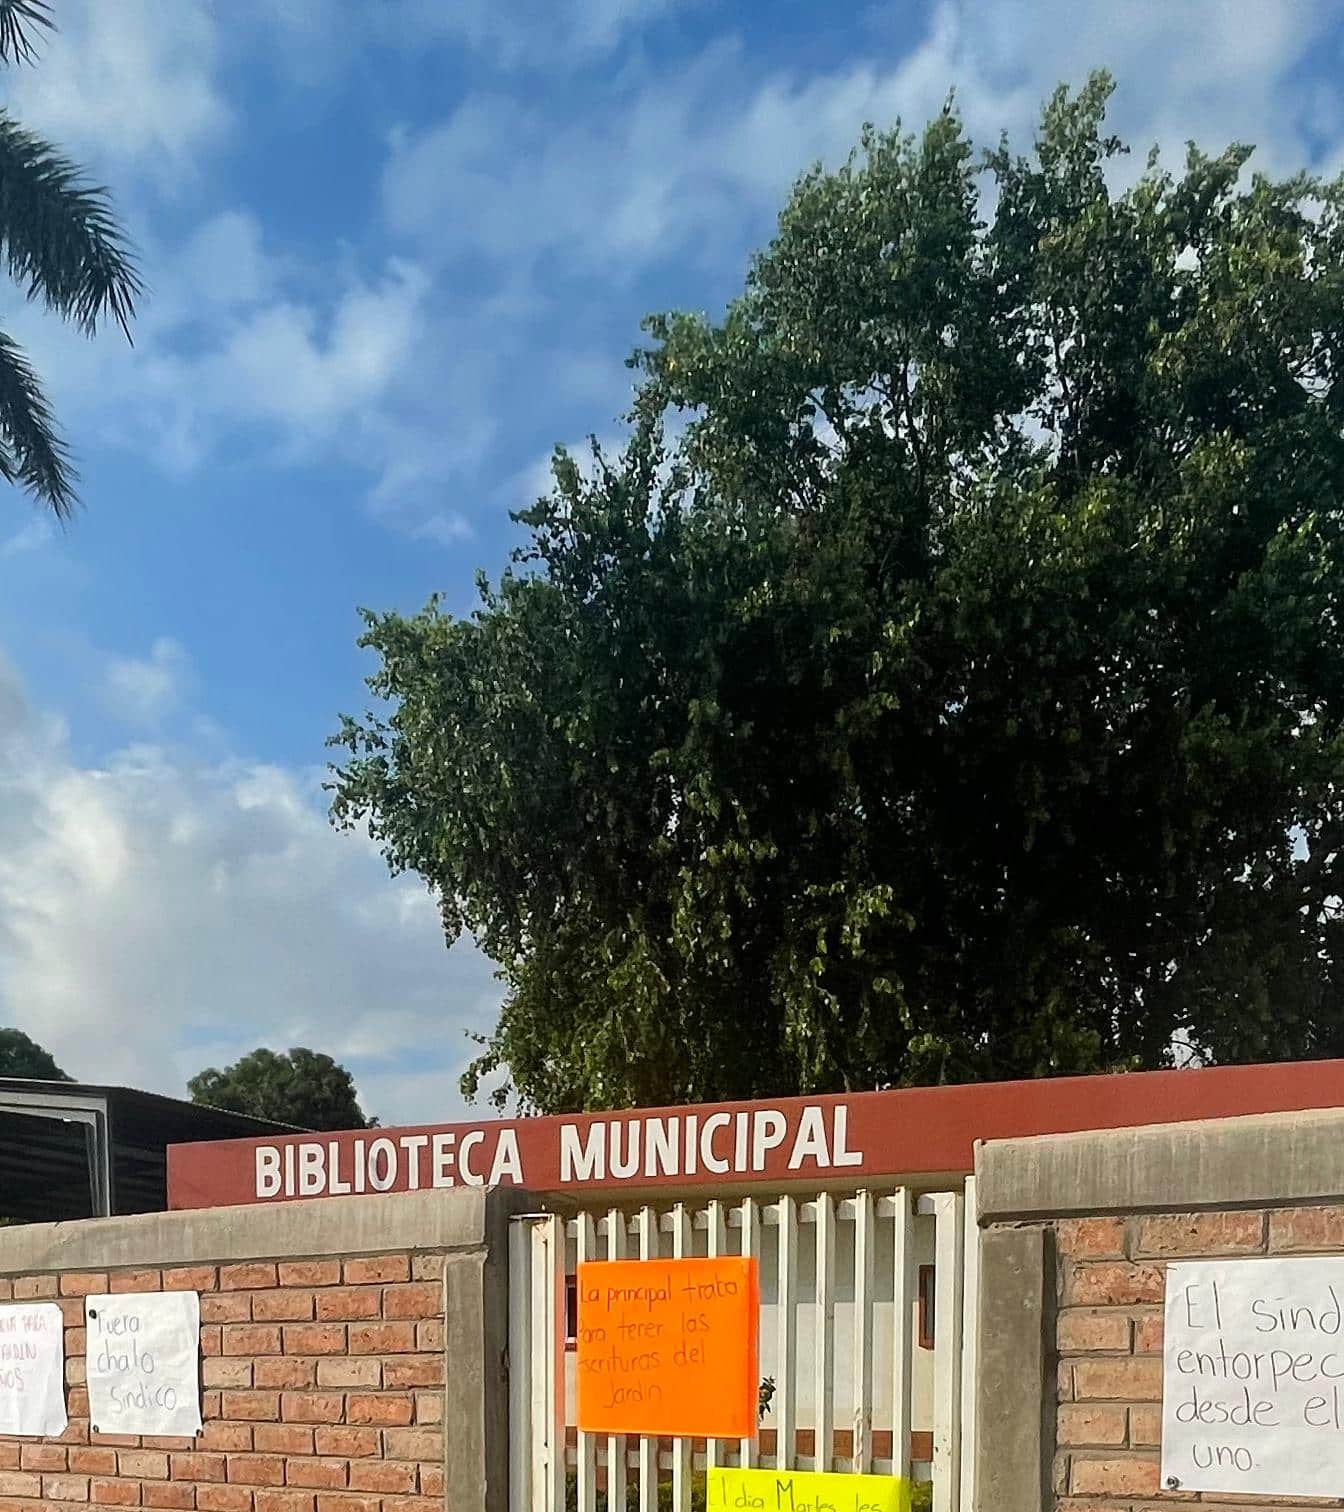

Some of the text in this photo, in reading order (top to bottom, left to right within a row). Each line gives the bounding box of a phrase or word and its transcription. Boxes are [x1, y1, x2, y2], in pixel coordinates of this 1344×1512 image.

[256, 1105, 862, 1198] BIBLIOTECA MUNICIPAL
[608, 1274, 671, 1312] principal
[682, 1272, 738, 1304] trato
[1185, 1280, 1222, 1330] El
[682, 1312, 710, 1334] las
[673, 1339, 705, 1368] del
[1175, 1386, 1280, 1427] desde
[1304, 1386, 1340, 1429] el
